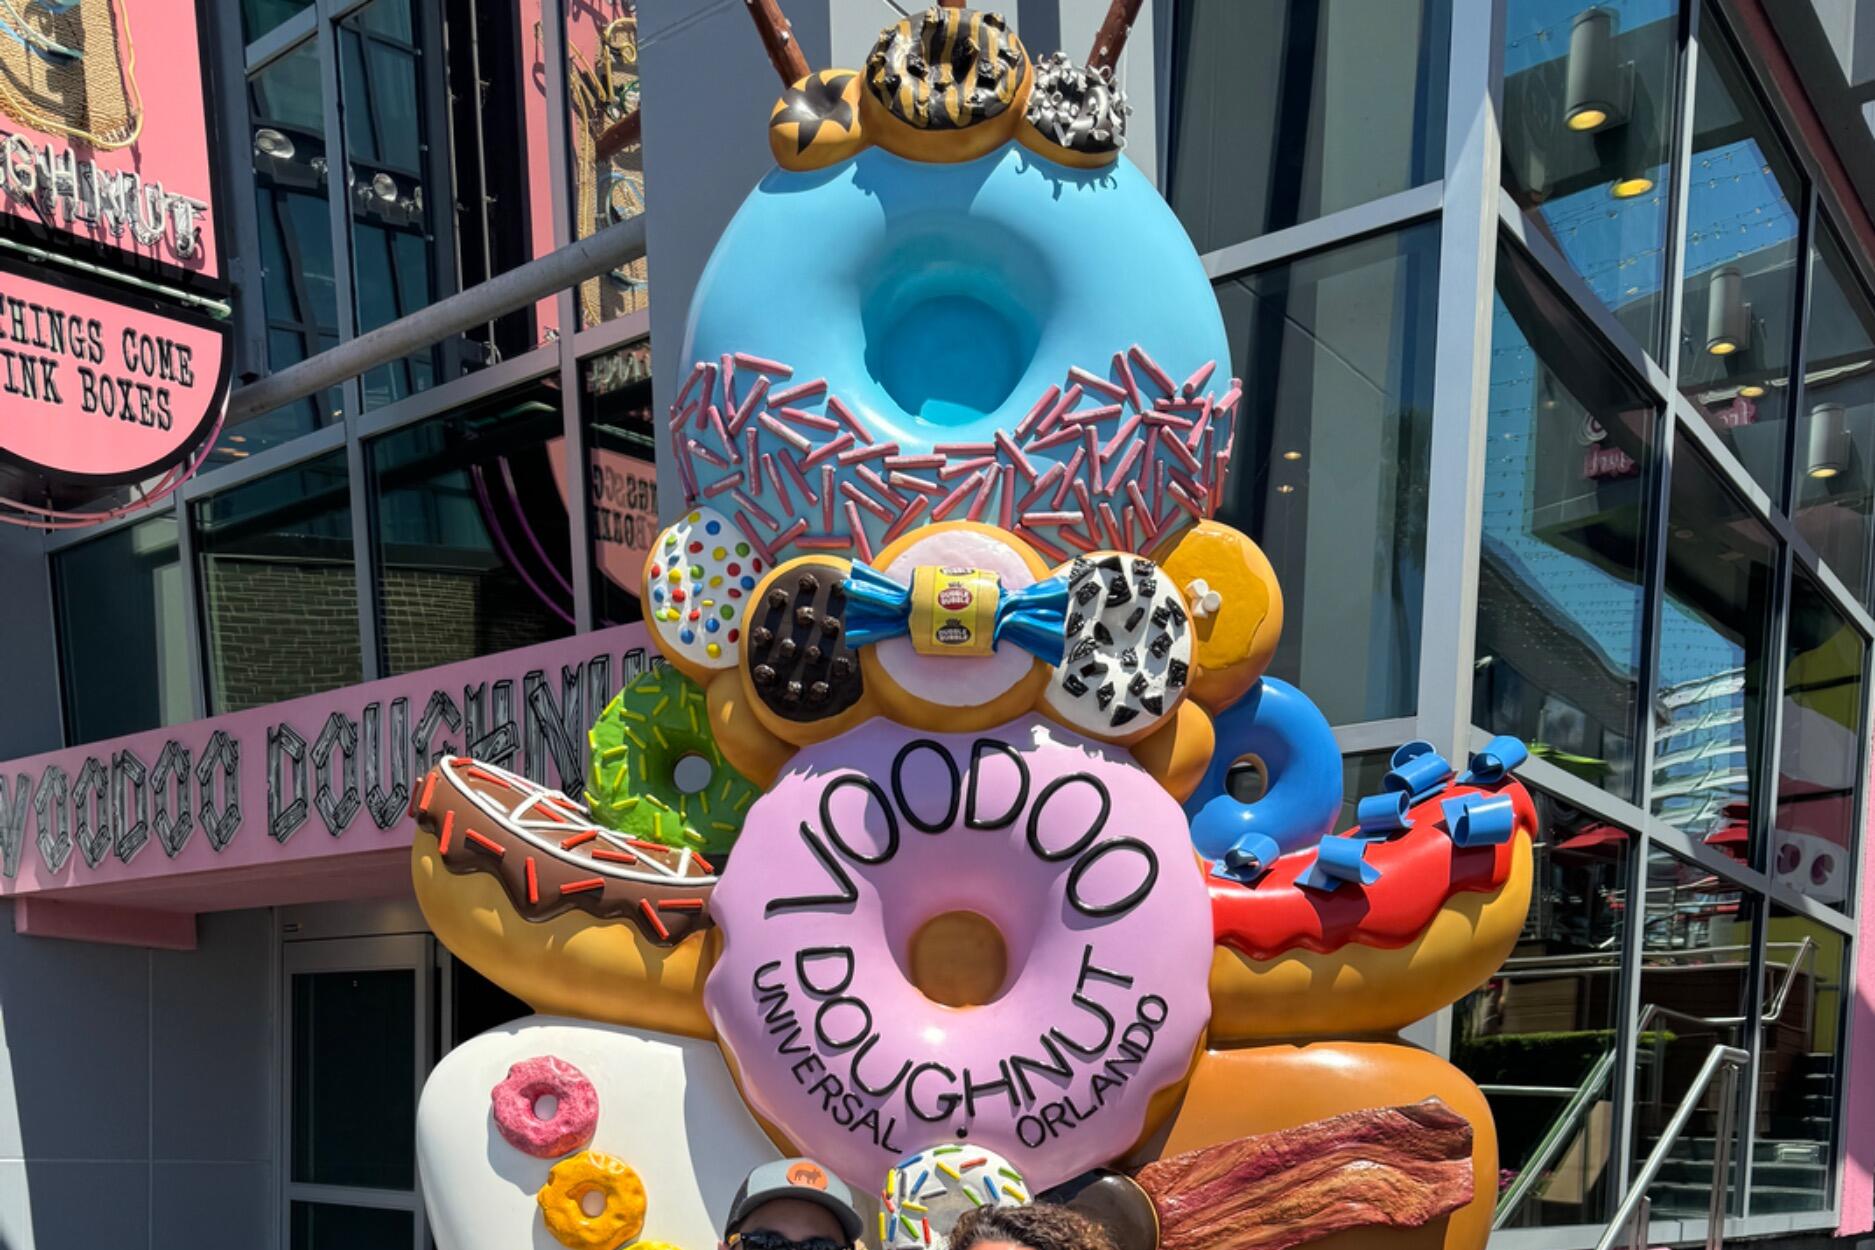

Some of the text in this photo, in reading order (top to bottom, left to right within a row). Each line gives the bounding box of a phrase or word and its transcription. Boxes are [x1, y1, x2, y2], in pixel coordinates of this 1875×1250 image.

[0, 133, 208, 260] GHNUT
[0, 348, 172, 432] INK BOXES
[122, 326, 194, 388] COME
[0, 648, 666, 878] VOODOO DOUGHN
[765, 738, 1159, 917] VOODOO
[753, 960, 1169, 1154] UNIVERSAL ORLANDO
[796, 944, 1134, 1122] DOUGHNUT
